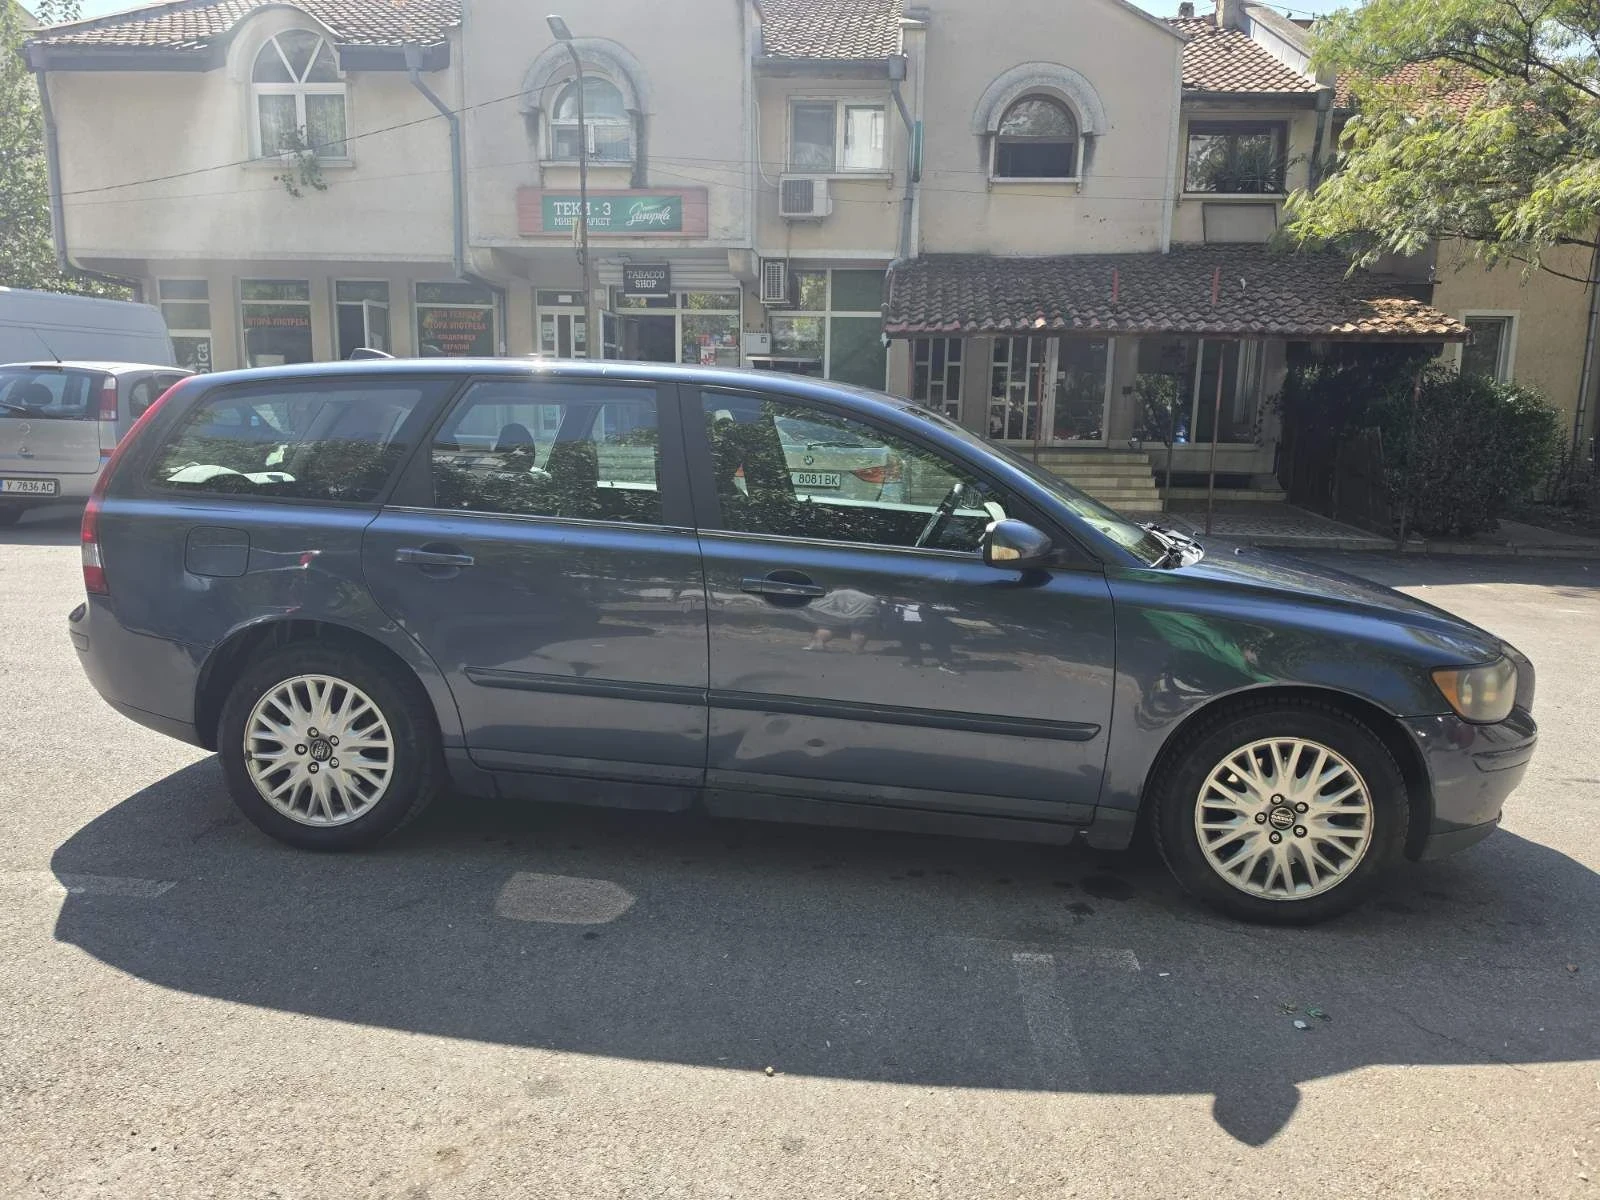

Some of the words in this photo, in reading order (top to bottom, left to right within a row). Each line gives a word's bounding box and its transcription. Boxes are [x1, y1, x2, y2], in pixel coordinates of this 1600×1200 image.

[602, 202, 611, 216] 3
[554, 217, 611, 226] МИНАРКЕТ
[626, 270, 665, 279] TABACCO
[635, 279, 657, 288] SHOP
[798, 473, 823, 485] 8081
[825, 474, 838, 486] BK
[16, 481, 39, 492] 7836
[41, 482, 53, 492] AC
